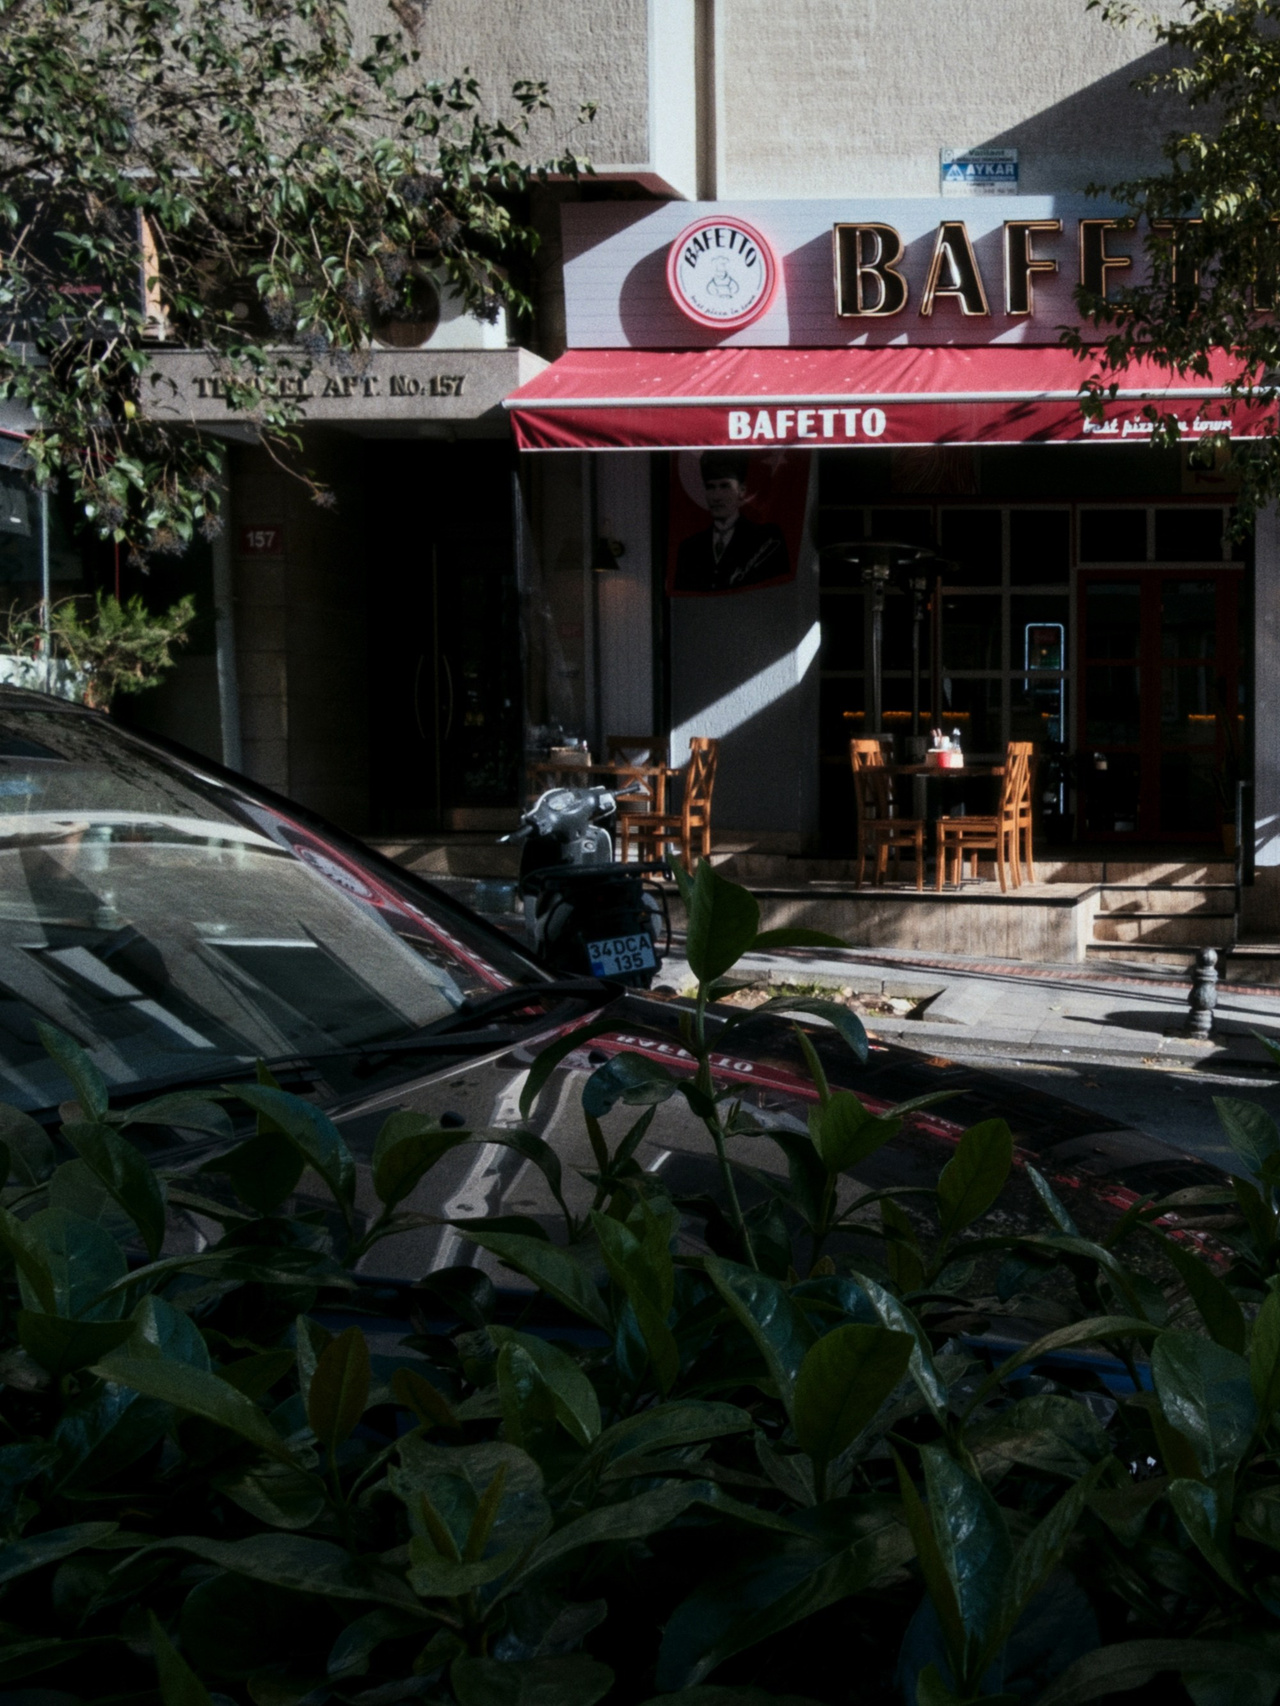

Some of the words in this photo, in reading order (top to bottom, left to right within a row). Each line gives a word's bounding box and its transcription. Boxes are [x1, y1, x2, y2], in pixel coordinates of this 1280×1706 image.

[966, 163, 1015, 175] AYKAR
[684, 228, 757, 268] BAFETTO
[429, 374, 468, 397] 157
[728, 408, 887, 440] BAFETTO
[1193, 416, 1232, 432] town
[246, 531, 276, 548] 157
[615, 952, 644, 971] 135
